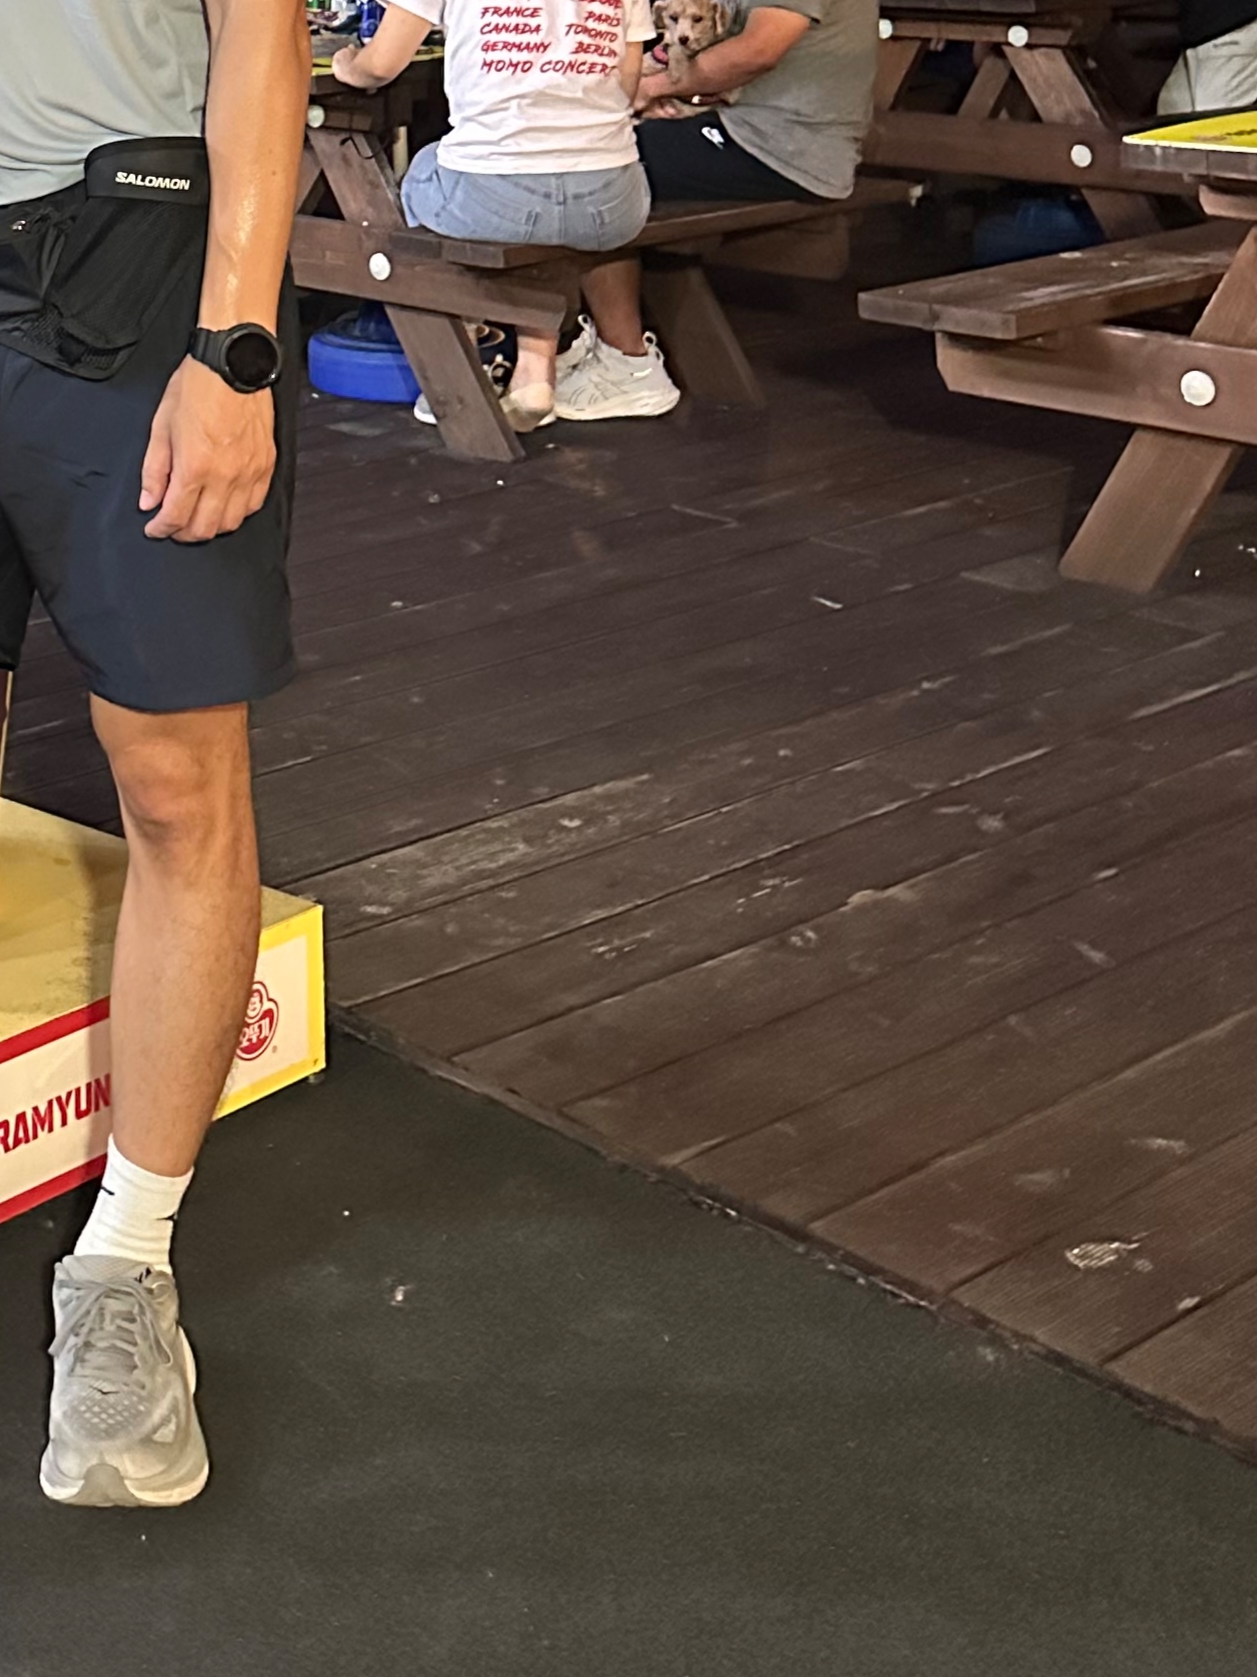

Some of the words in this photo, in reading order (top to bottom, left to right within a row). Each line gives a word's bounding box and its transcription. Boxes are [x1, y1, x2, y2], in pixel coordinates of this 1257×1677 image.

[480, 6, 543, 19] FRANCE
[585, 11, 621, 27] PARIS
[480, 22, 541, 35] CANADA
[565, 23, 618, 42] TORONTO
[480, 40, 551, 55] GERMANY
[115, 171, 190, 191] SALOMON
